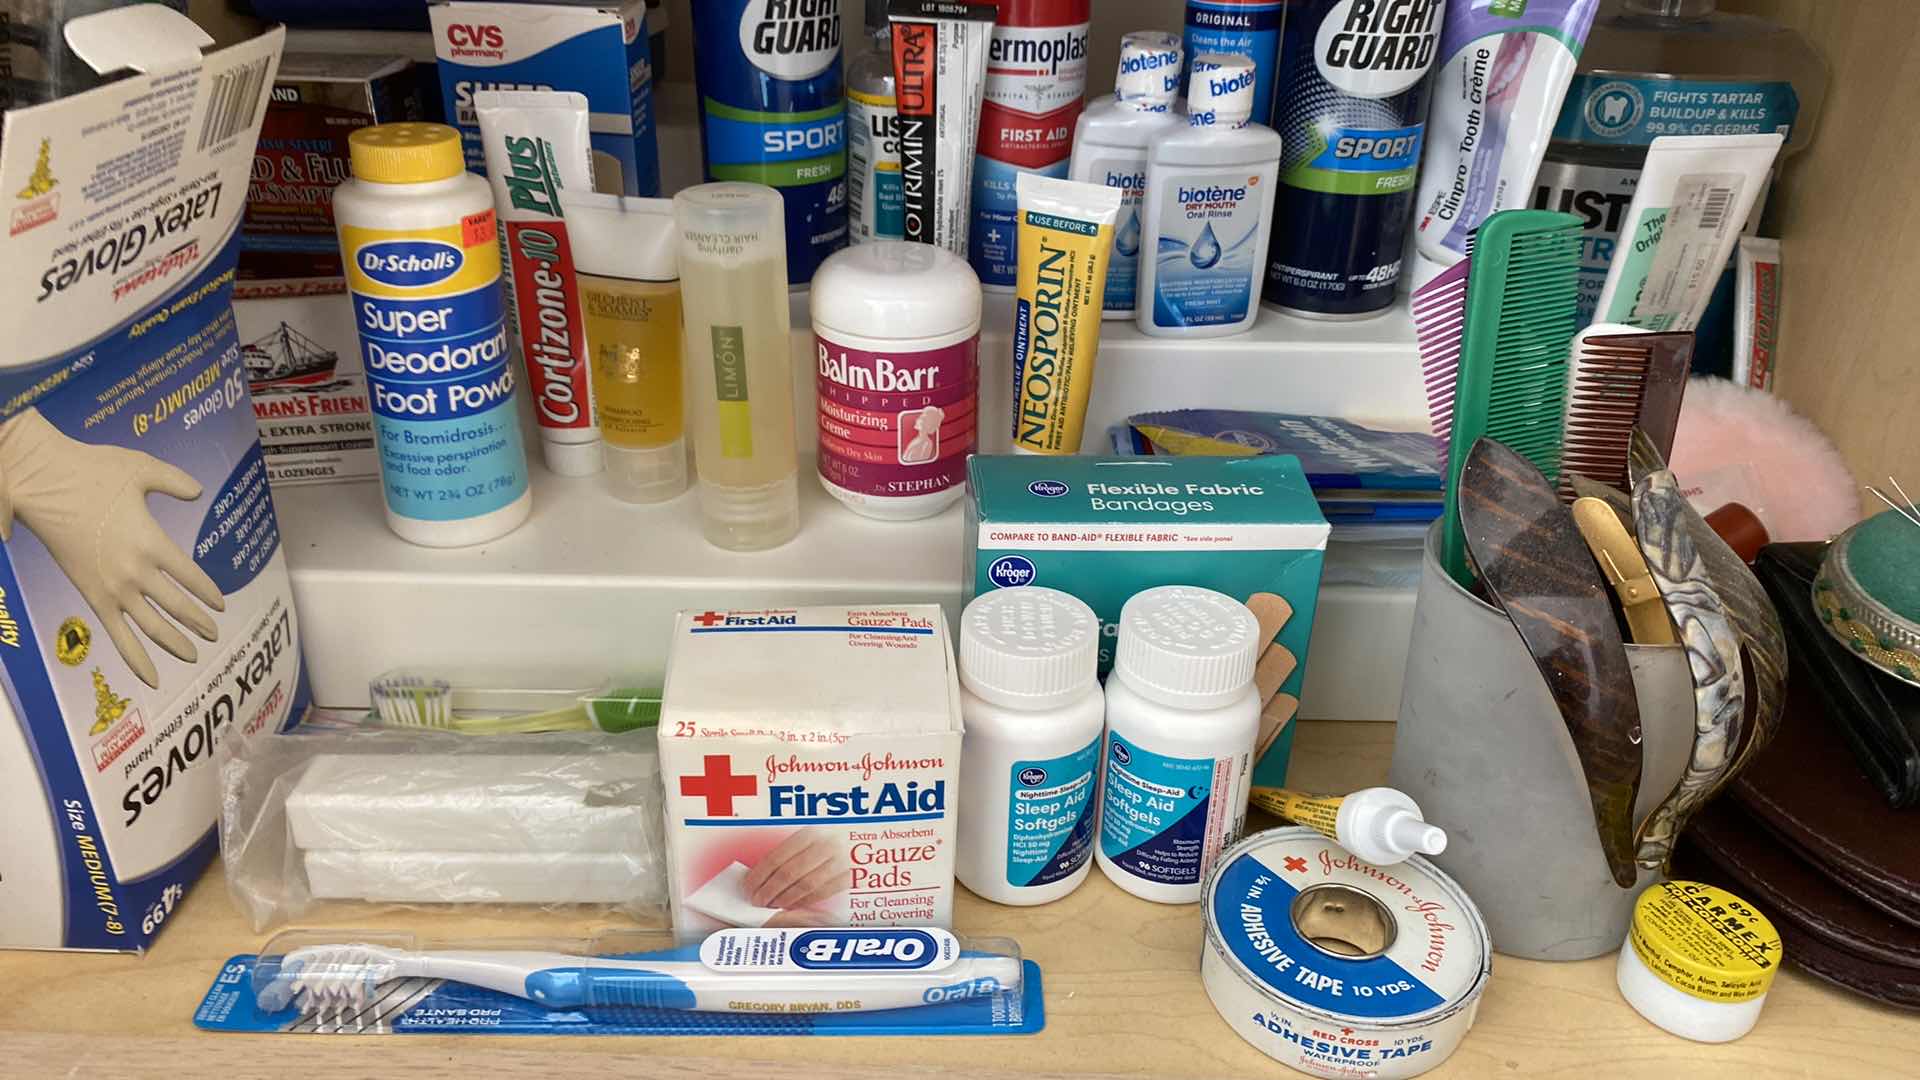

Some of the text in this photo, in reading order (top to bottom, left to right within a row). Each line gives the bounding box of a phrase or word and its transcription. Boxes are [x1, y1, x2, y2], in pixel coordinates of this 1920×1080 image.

[1195, 12, 1251, 26] ORIGINAL
[1343, 0, 1443, 34] RIGHT
[448, 24, 504, 47] CVS
[753, 15, 840, 54] GUARD
[1219, 36, 1236, 46] the
[1237, 38, 1252, 47] Air
[451, 47, 504, 59] pharmacy
[1120, 51, 1178, 75] biotène
[1325, 34, 1436, 71] GUARD
[1654, 90, 1764, 105] FIGHTS TARTAR
[1650, 107, 1765, 120] BUILDUP & KILLS
[764, 120, 845, 152] SPORT
[1001, 127, 1068, 142] FIRST AID
[1437, 164, 1468, 221] Clinpro
[1459, 106, 1481, 153] Tooth
[1470, 48, 1490, 103] Crème
[1692, 125, 1712, 135] OF
[1713, 125, 1761, 135] GERMS
[1335, 136, 1417, 159] SPORT
[281, 155, 301, 182] &
[504, 135, 555, 216] Plus
[797, 165, 831, 179] FRESH
[1375, 175, 1410, 189] FRESH
[1178, 185, 1246, 203] biotène
[150, 182, 222, 239] Latex
[1185, 202, 1236, 211] DRY MOUTH
[1186, 209, 1233, 219] Oral Rinse
[1034, 215, 1087, 232] USE BEFORE
[1644, 214, 1667, 233] The
[743, 233, 759, 242] HAIR
[37, 226, 146, 303] Gloves
[1070, 278, 1083, 317] OINTMENT
[363, 302, 453, 337] Super
[1012, 305, 1033, 360] OINTMENT
[1064, 318, 1079, 356] RELIEVING
[716, 335, 739, 399] LIMÓN
[819, 343, 939, 392] BalmBarr
[183, 368, 244, 431] 50 Gloves
[374, 364, 514, 414] Foot Powd
[132, 367, 223, 437] MEDIUM(7-8)
[309, 394, 368, 416] FRIEN
[820, 399, 889, 431] Moisturizing
[271, 425, 316, 437] EXTRA
[381, 425, 400, 442] For
[821, 419, 851, 439] Creme
[1054, 430, 1063, 450] FIRST
[383, 439, 507, 465] Excessive perspiration
[846, 447, 883, 462] Dry Skin
[278, 466, 335, 479] LOZENGES
[386, 462, 471, 476] and foot odor.
[390, 484, 485, 500] NET WT OZ
[887, 474, 950, 492] STEPHAN
[1032, 481, 1264, 496] Kroger Flexible Fabric
[1092, 498, 1214, 516] Bandages
[990, 532, 1035, 542] COMPARE
[1037, 533, 1049, 542] TO
[1105, 533, 1143, 542] FLEXIBLE
[1146, 533, 1179, 542] FABRIC
[994, 560, 1030, 585] Kroger
[726, 616, 762, 625] First
[766, 616, 796, 624] Aid
[848, 617, 933, 627] Gauze Pads
[849, 640, 883, 648] Covering
[236, 608, 293, 703] Latex
[154, 716, 183, 748] Either
[675, 721, 816, 742] 25 2 in. x 2
[121, 694, 234, 829] Gloves
[123, 746, 154, 779] Hand
[766, 752, 944, 784] Johnson Johnson
[1022, 770, 1043, 783] Kroger
[768, 780, 945, 817] First Aid
[1021, 791, 1057, 799] Nighttime
[1108, 773, 1175, 812] Sleep Aid
[1141, 782, 1180, 796] Sleep-Aid
[1015, 787, 1085, 815] Sleep Aid
[1107, 788, 1161, 826] Softgels
[1015, 811, 1076, 831] Softgels
[849, 828, 935, 842] Extra Absorbent
[850, 842, 936, 866] Gauze
[63, 798, 126, 936] Size MEDIUM(7-8)
[1138, 861, 1196, 875] 96 SOFTGELS
[850, 867, 912, 890] Pads
[850, 894, 934, 909] For Cleansing
[1318, 850, 1455, 973] Johnson Johnson
[850, 907, 934, 922] And Covering
[1685, 885, 1772, 954] CARMEX
[805, 936, 925, 961] Oral-B
[1240, 886, 1416, 997] IN. ADHESIVE TAPE 10 YDS.
[1664, 960, 1718, 987] Camphor, Alum,
[1675, 976, 1695, 991] Cocoa
[1697, 985, 1718, 997] Butter
[728, 1000, 787, 1012] GREGORY
[836, 1000, 862, 1010] DDS
[1252, 1012, 1432, 1059] ADHESIVE TAPE
[1312, 1029, 1379, 1046] RED CROSS
[1303, 1049, 1379, 1067] WATERPROOF
